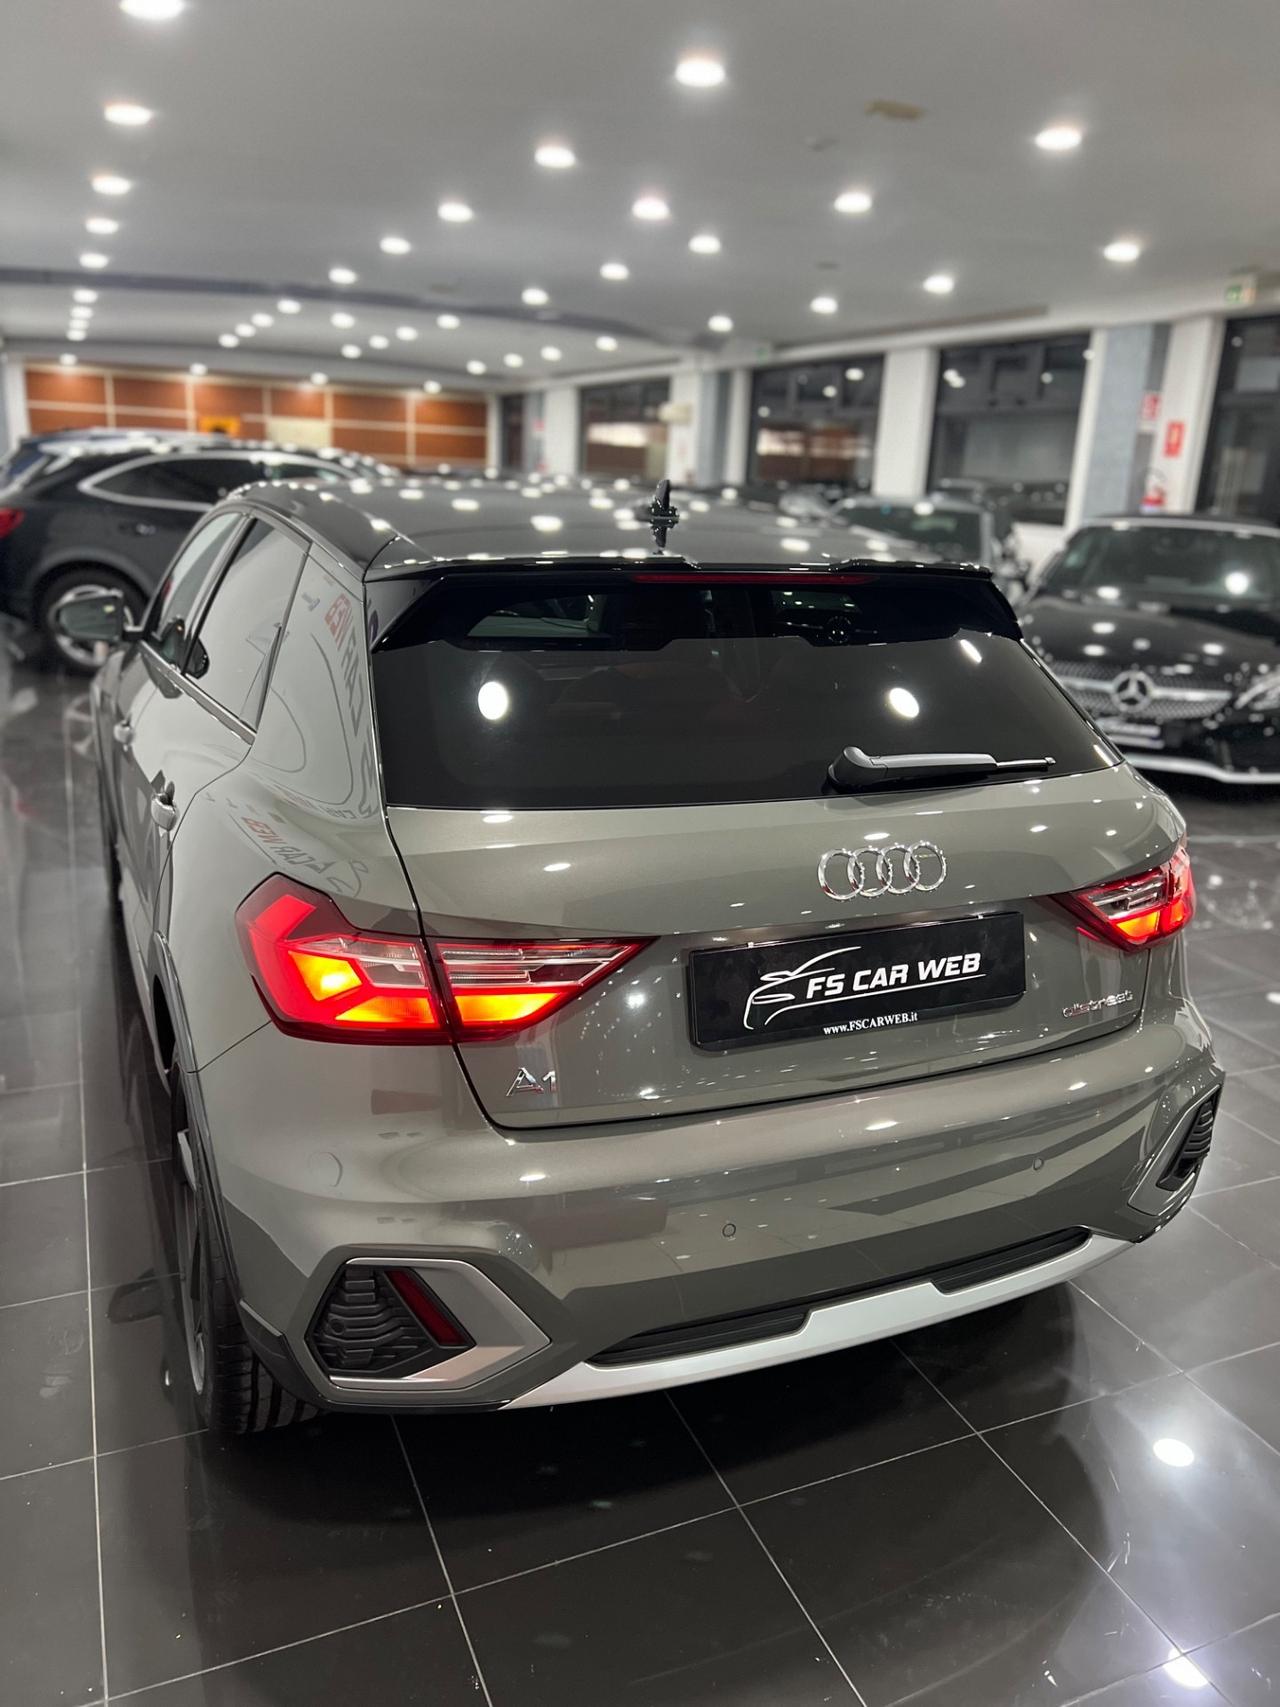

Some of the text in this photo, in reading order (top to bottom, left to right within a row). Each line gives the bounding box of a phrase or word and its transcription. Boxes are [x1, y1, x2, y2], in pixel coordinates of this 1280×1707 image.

[806, 952, 982, 999] FS CAR WEB
[823, 1011, 918, 1035] www.FSCARWEB.it
[506, 1067, 556, 1096] A1
